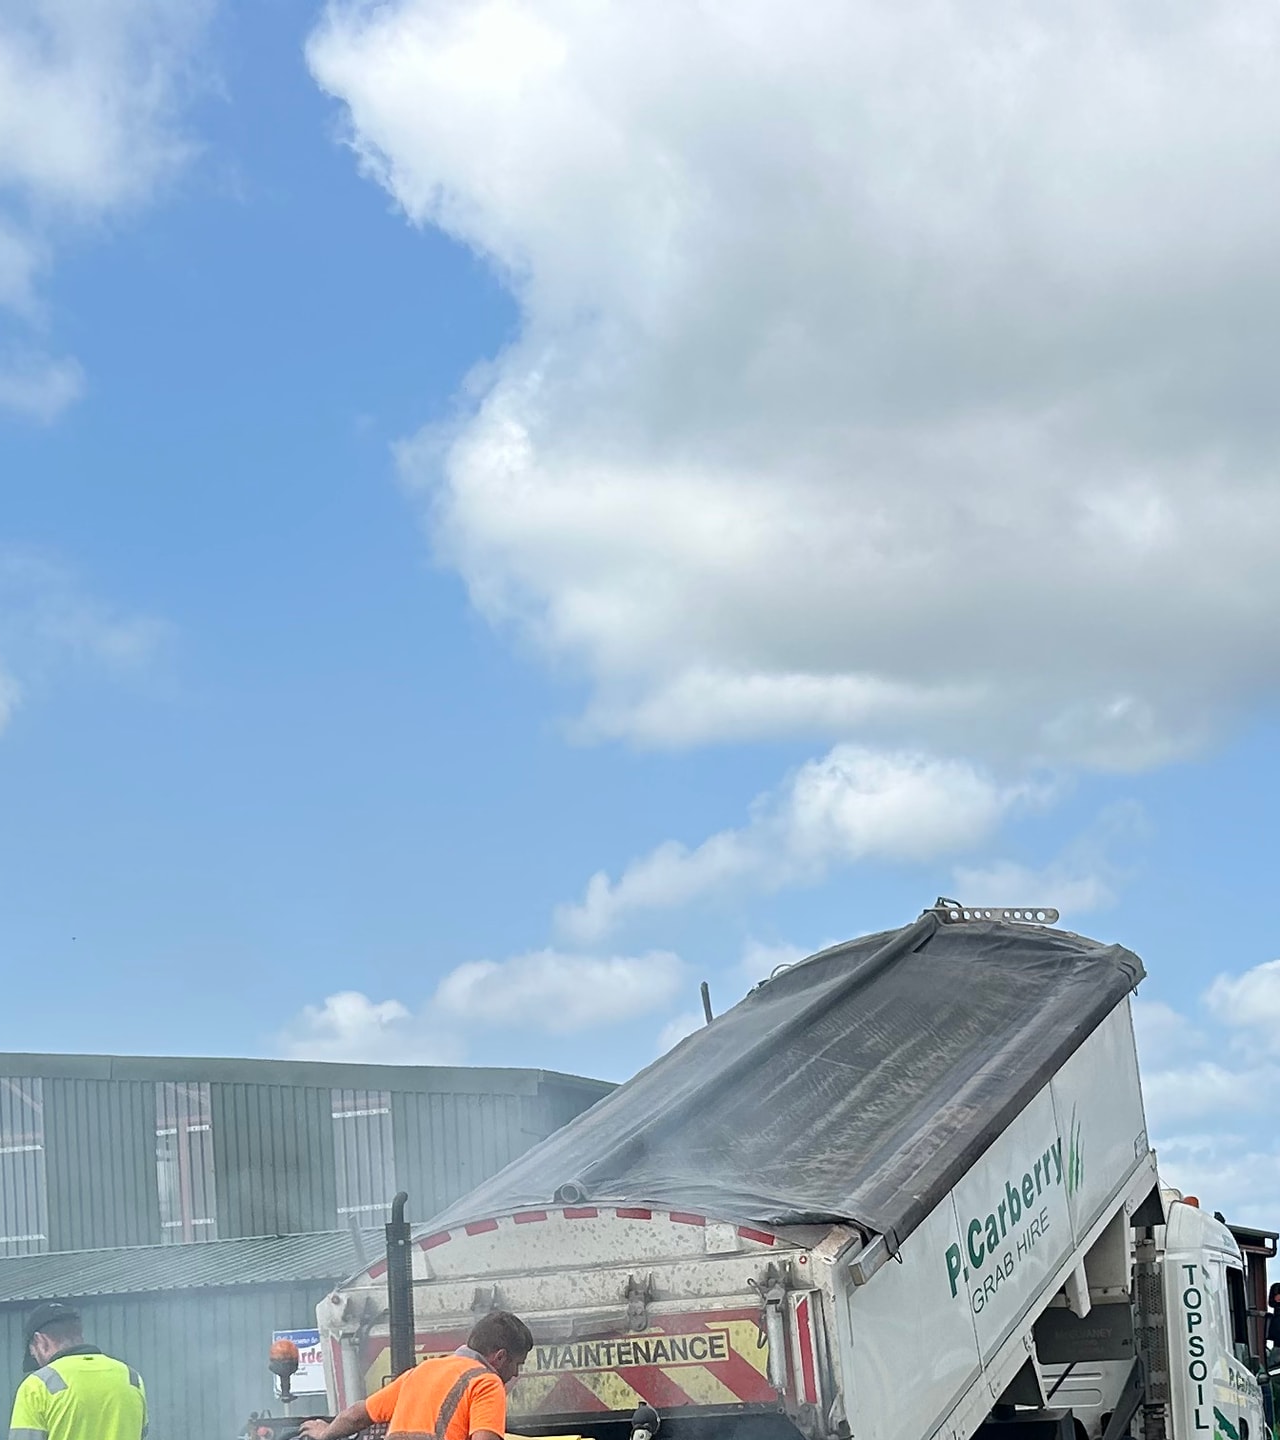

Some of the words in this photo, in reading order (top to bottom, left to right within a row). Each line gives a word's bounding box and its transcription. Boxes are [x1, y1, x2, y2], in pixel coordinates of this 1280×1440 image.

[972, 1252, 1014, 1314] GRAB
[1016, 1207, 1050, 1262] HIRE
[536, 1334, 727, 1371] MAINTENANCE
[1182, 1264, 1209, 1429] TOPSOIL
